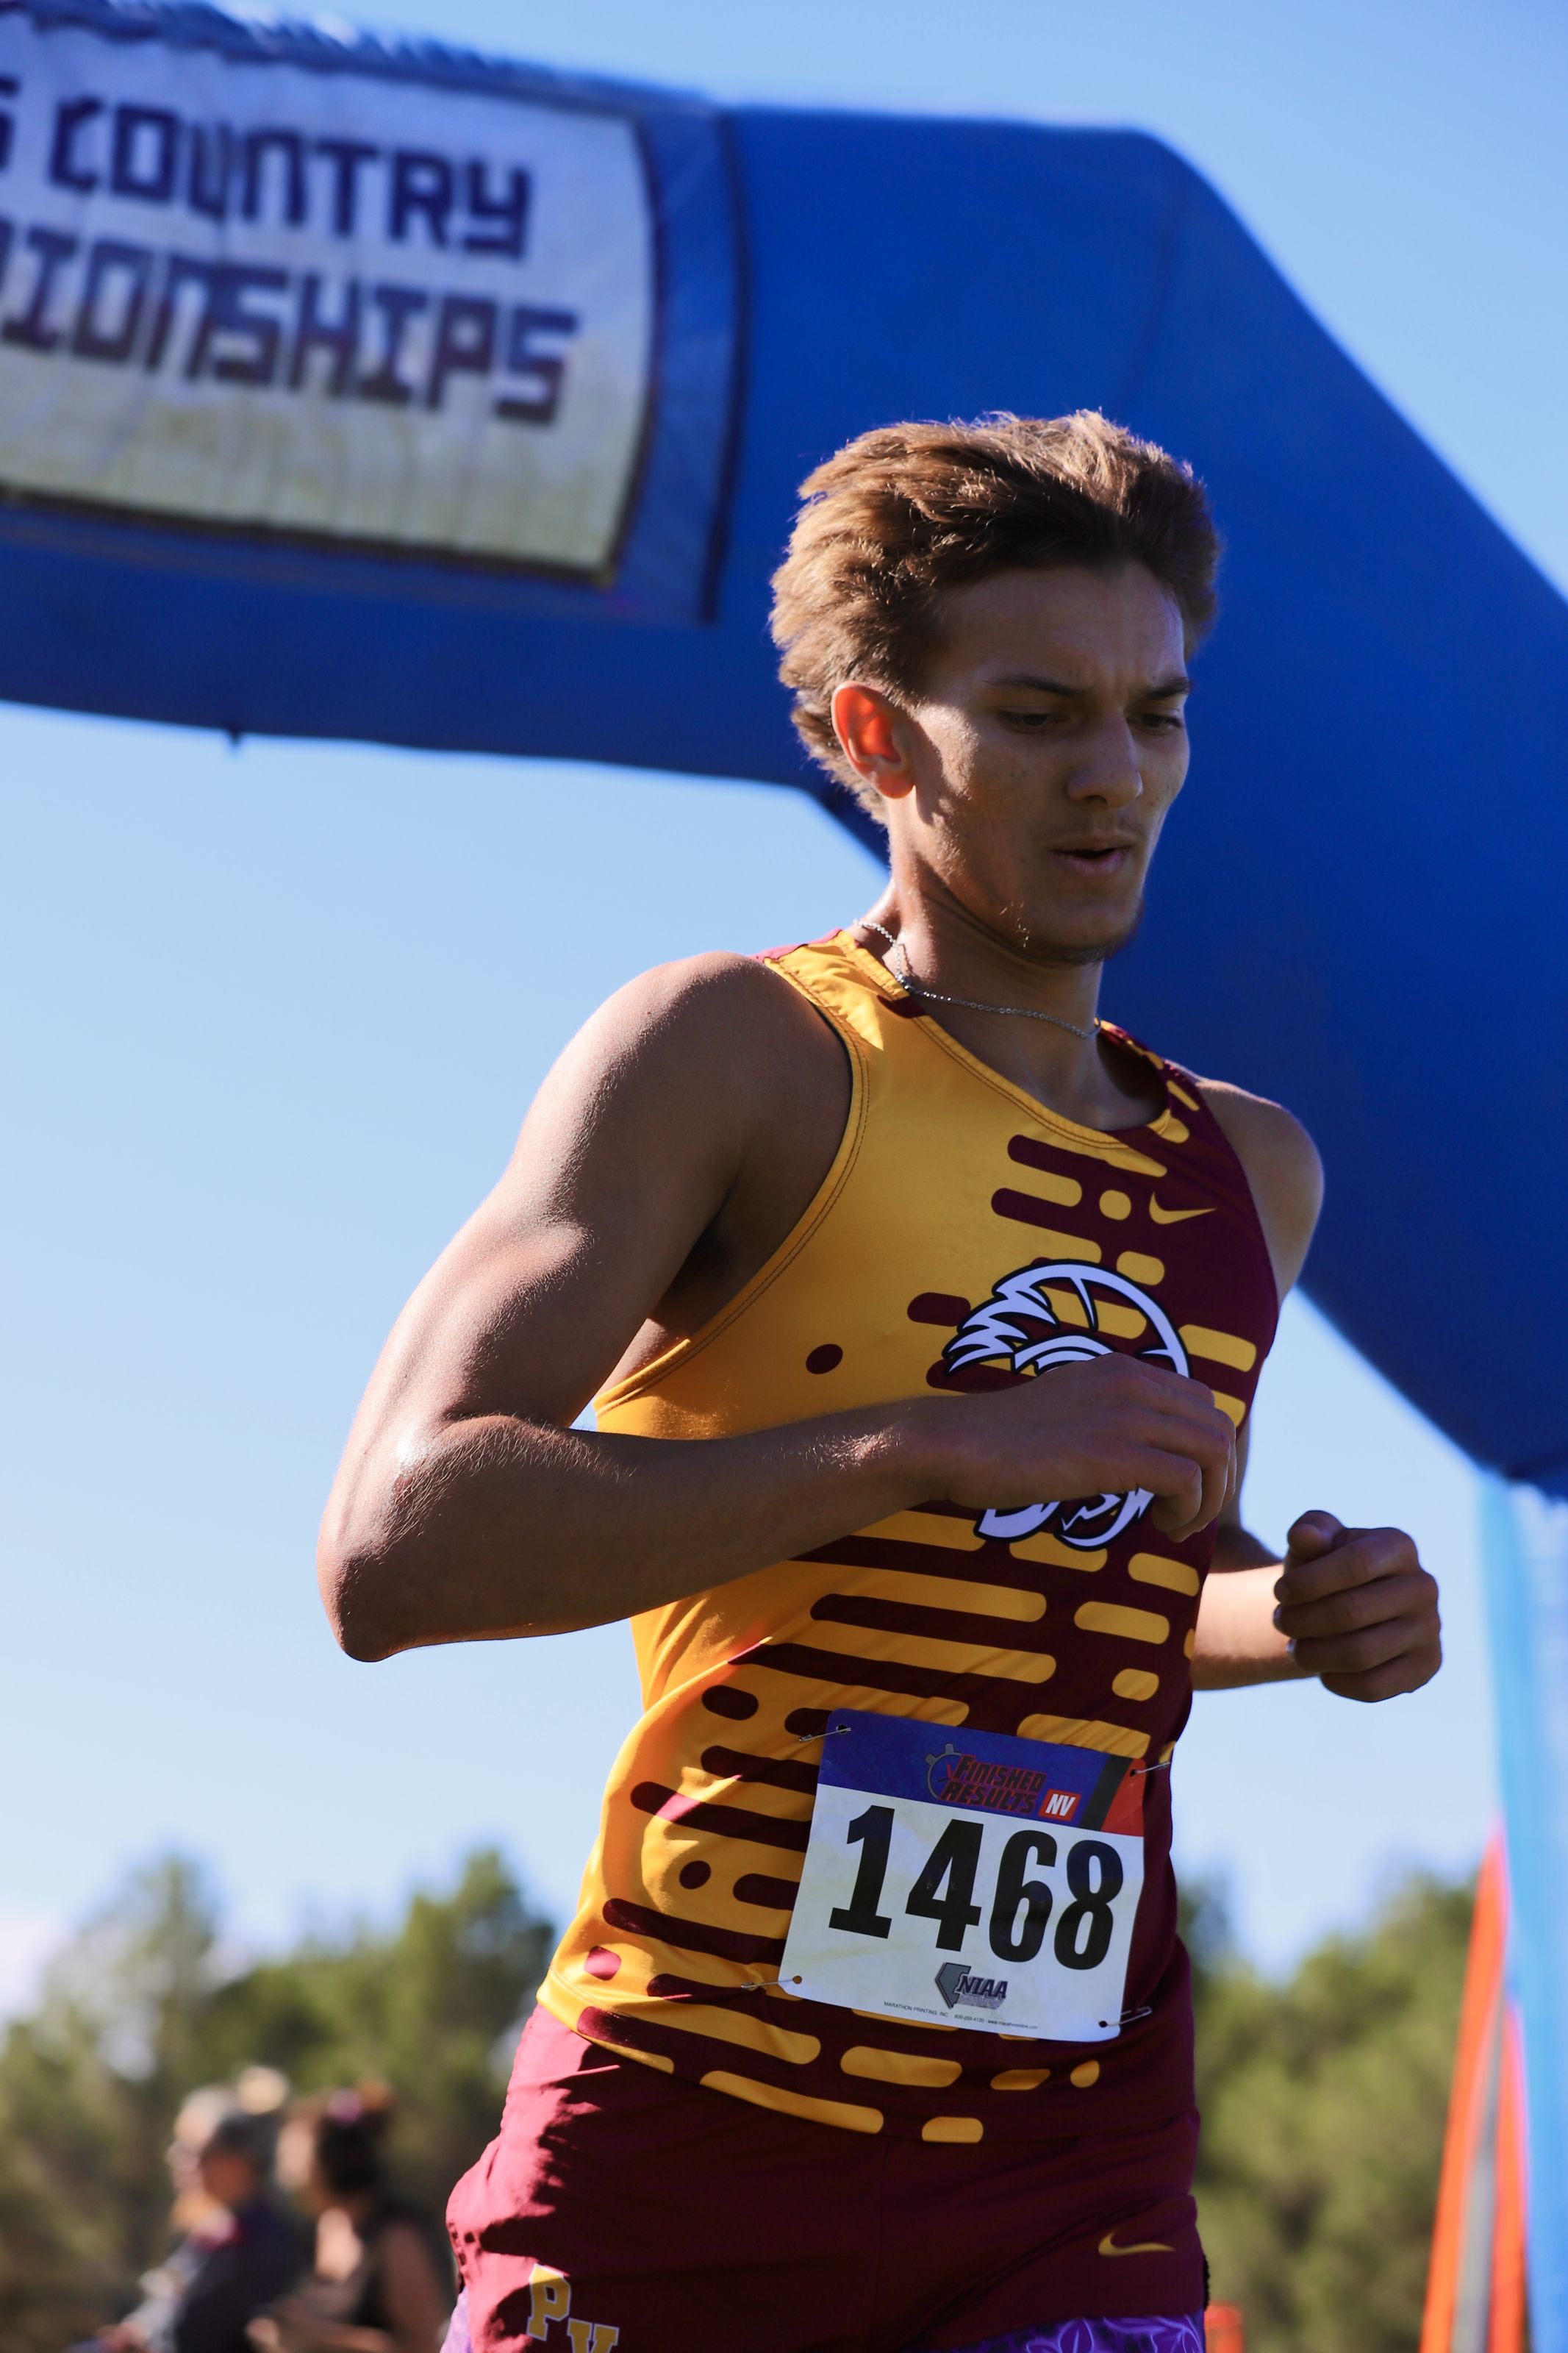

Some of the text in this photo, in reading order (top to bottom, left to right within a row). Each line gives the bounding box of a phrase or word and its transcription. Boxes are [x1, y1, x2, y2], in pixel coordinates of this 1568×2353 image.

[49, 96, 532, 261] COUNTRY
[0, 219, 579, 428] IONSHIPS
[952, 1754, 1047, 1793] FINISHED
[938, 1778, 1037, 1814] RESULTS
[1045, 1793, 1076, 1816] NV
[828, 1804, 1123, 1971] 1468
[956, 1974, 1009, 1999] NIAA
[884, 2001, 912, 2011] MARATHON
